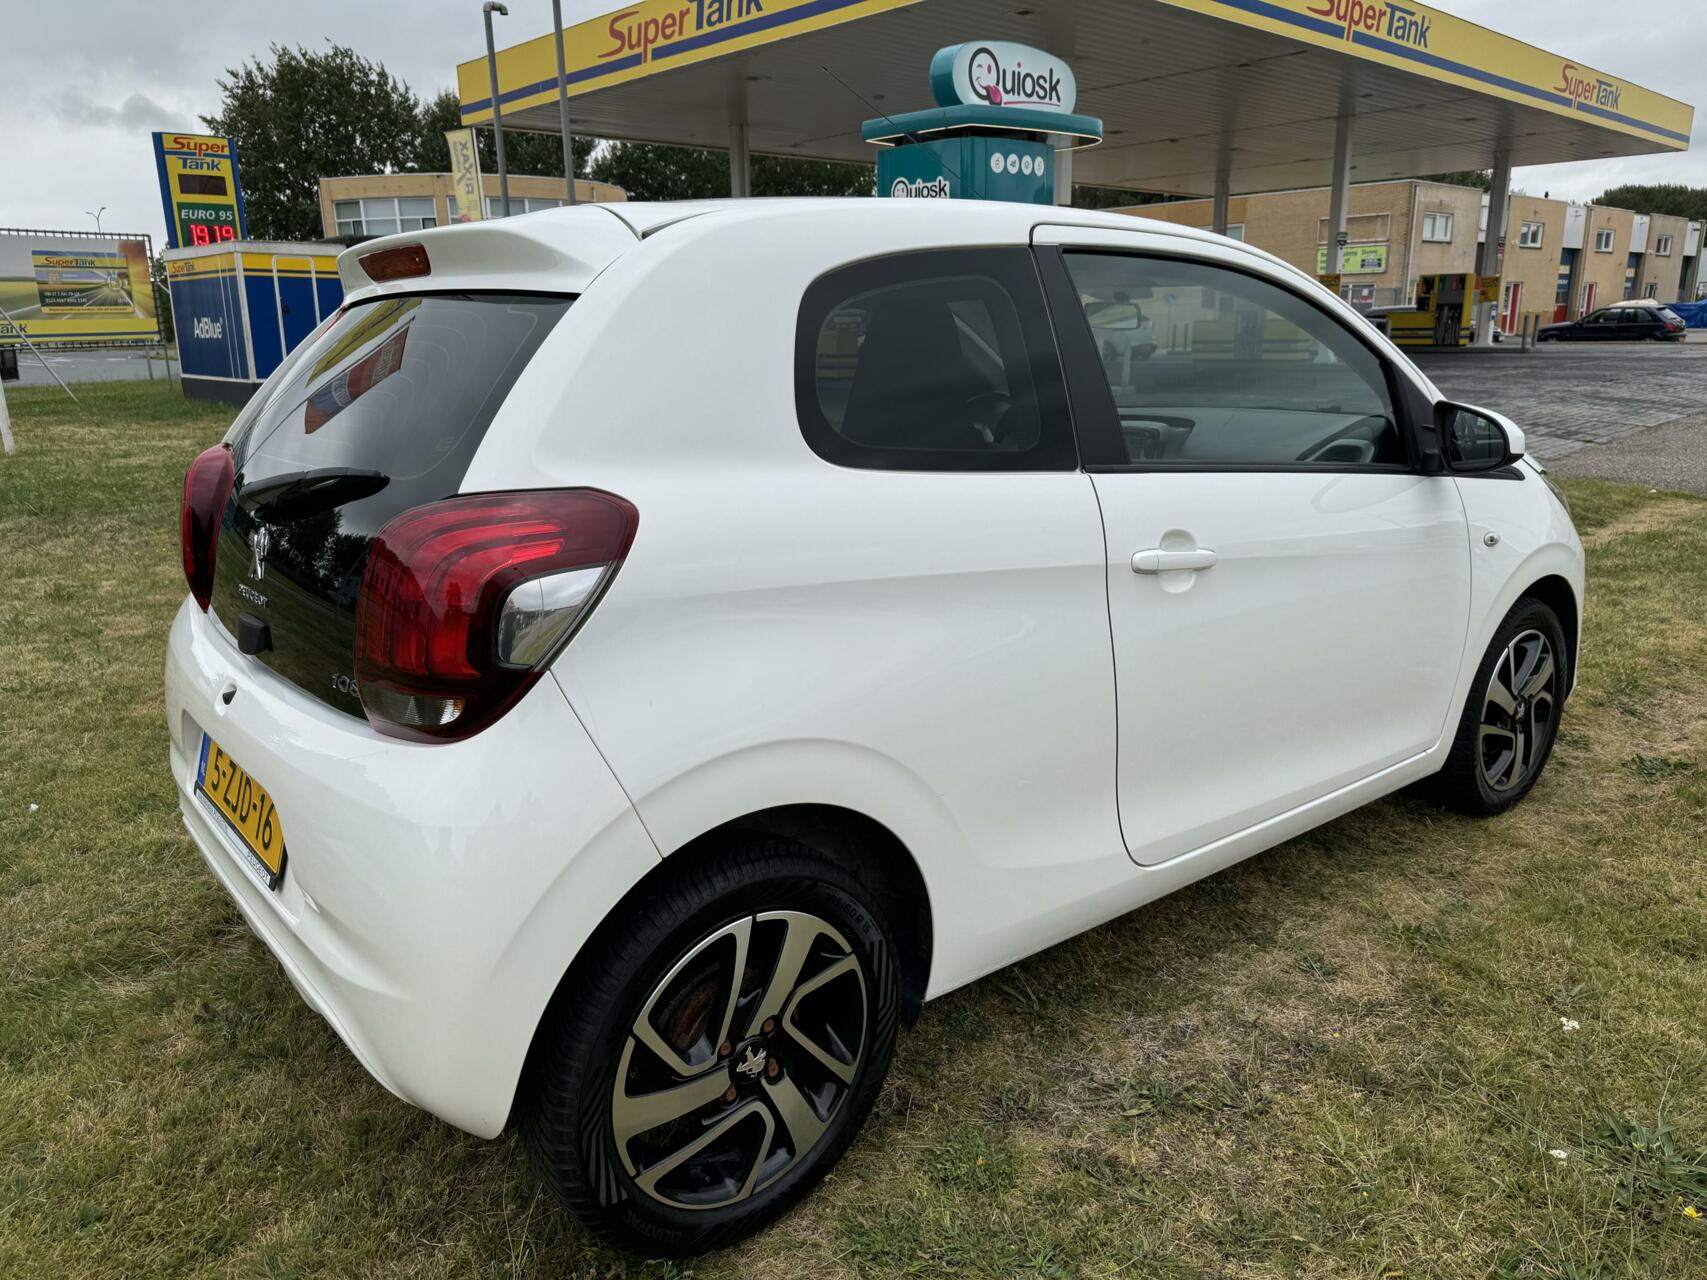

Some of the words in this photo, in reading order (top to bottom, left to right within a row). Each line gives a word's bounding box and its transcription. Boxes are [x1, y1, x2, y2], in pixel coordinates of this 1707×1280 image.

[968, 47, 1061, 105] Quiosk
[1553, 64, 1621, 110] SuperTank
[172, 137, 227, 157] Super
[177, 157, 221, 171] Tank
[893, 176, 948, 198] Quiosk
[181, 209, 214, 220] EURO
[219, 210, 233, 221] 95
[44, 257, 96, 266] SuperTank
[238, 583, 269, 608] PEUGEOT
[211, 746, 275, 850] 5-ZJD-16
